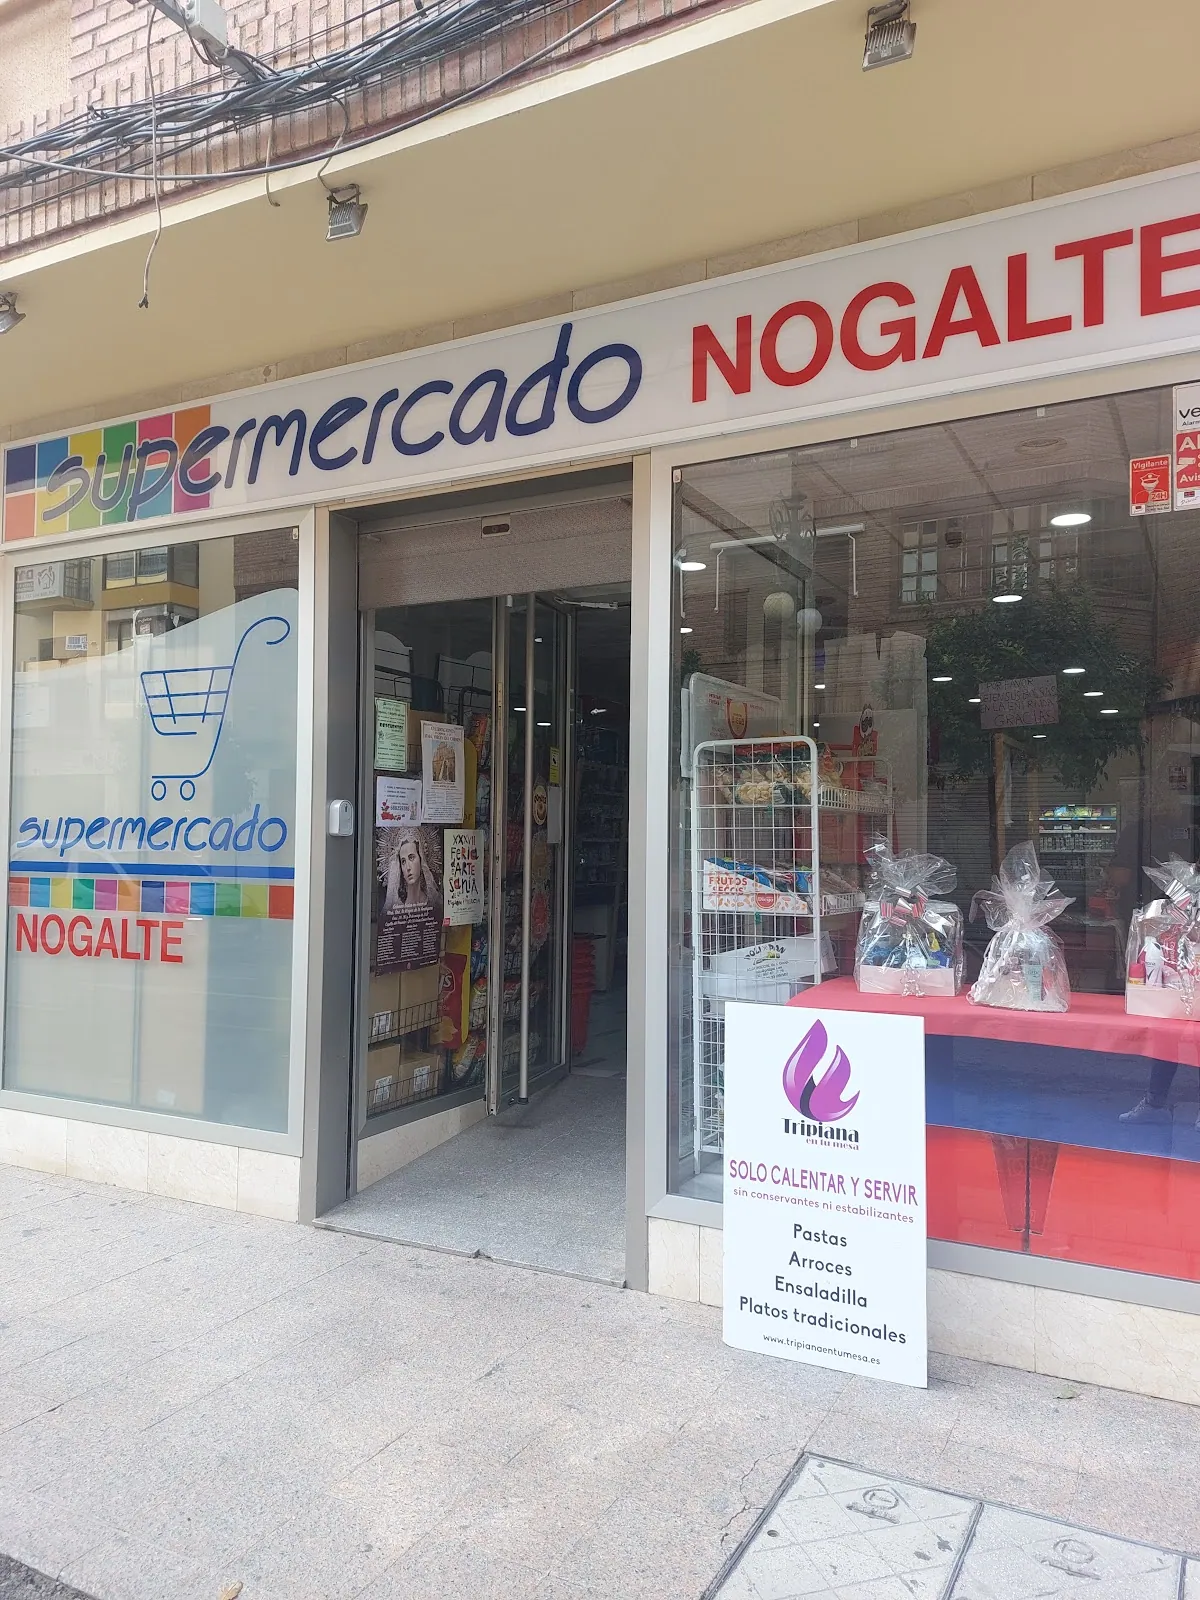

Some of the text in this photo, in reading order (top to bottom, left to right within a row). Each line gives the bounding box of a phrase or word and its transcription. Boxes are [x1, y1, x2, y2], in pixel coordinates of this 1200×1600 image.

[42, 213, 1200, 522] supermercado NOGALTE
[1132, 459, 1169, 471] Vigilante
[1151, 491, 1167, 501] 24H
[994, 709, 1056, 727] GRACIAS
[16, 804, 288, 857] supermercado
[708, 876, 748, 887] FRUTOS
[16, 913, 185, 964] NOGALTE
[782, 1118, 860, 1143] Tripiana
[806, 1138, 860, 1151] en tu mesa
[730, 1159, 919, 1207] SOLO CALENTAR Y SERVIR
[733, 1187, 915, 1224] sin conservantes ni estabilizantes
[793, 1223, 848, 1248] Pastas
[788, 1250, 853, 1277] Arroces
[774, 1275, 868, 1309] Ensaladilla
[739, 1296, 907, 1345] Platos tradicionales
[762, 1333, 881, 1366] www.tripianaentumesa.es
